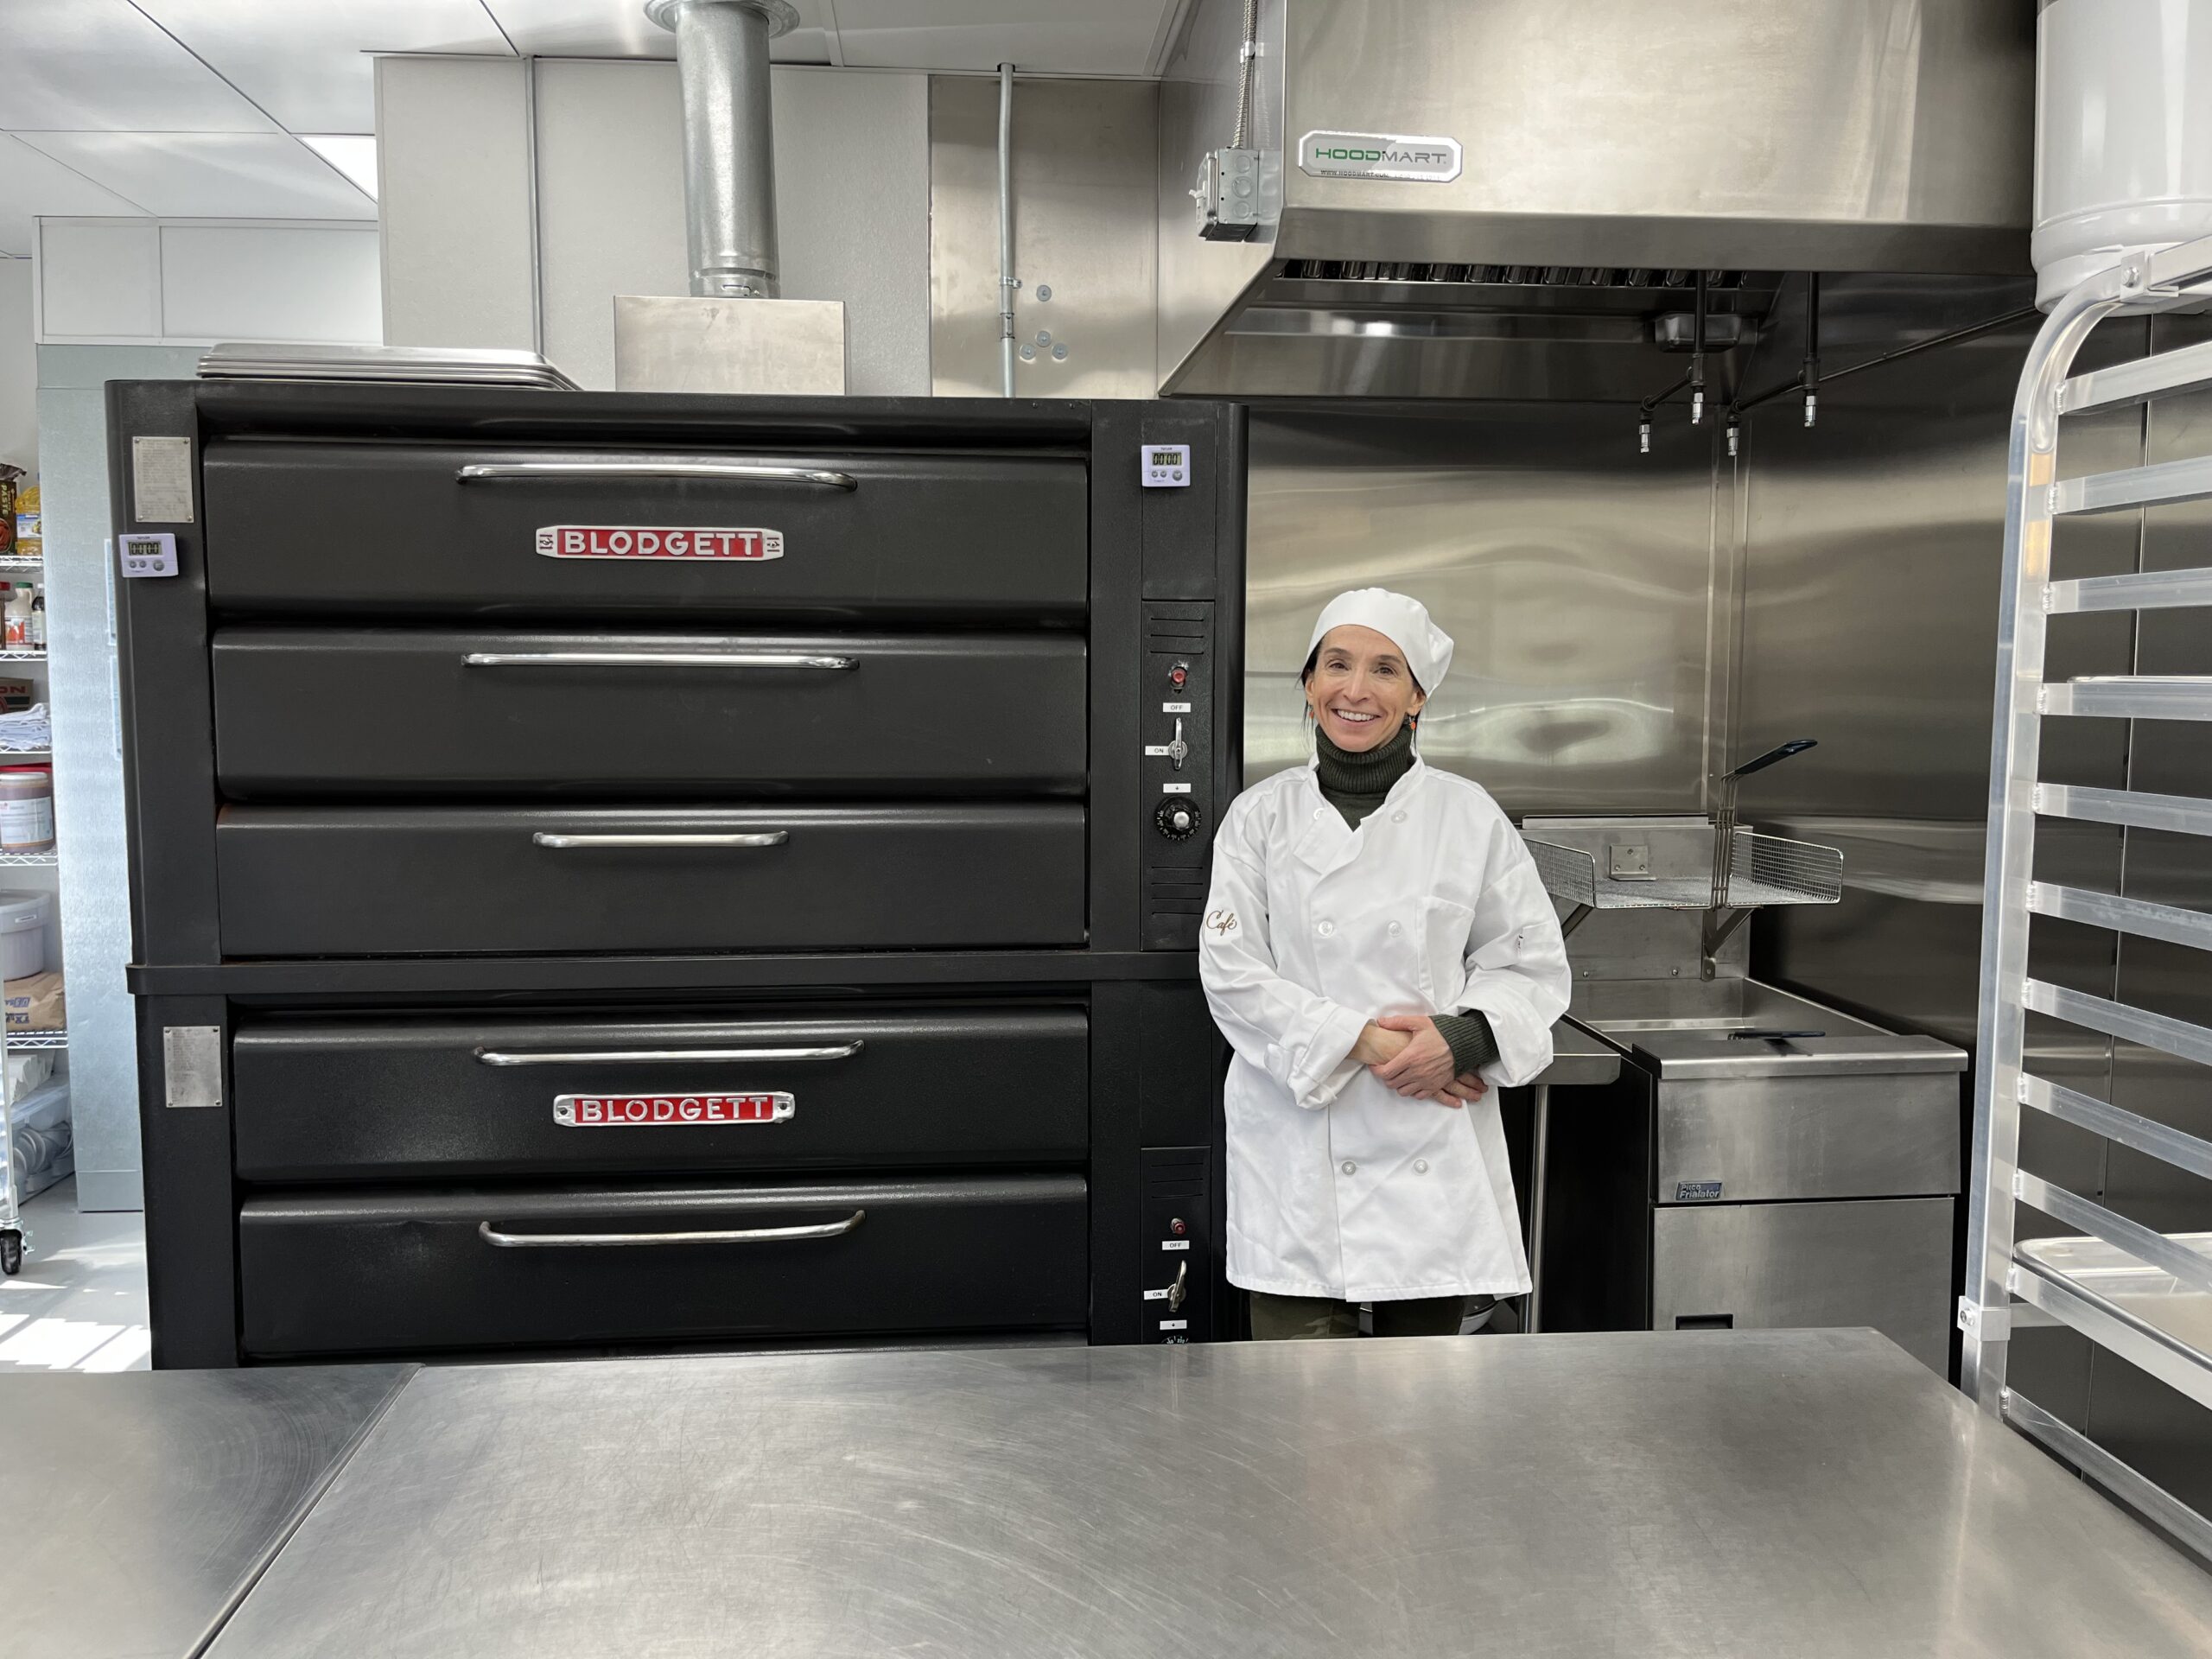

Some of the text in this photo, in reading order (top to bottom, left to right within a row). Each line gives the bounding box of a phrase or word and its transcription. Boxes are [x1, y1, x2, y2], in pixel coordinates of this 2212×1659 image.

[1316, 148, 1446, 163] HOODMART
[564, 531, 759, 556] BLODGETT
[1205, 909, 1237, 937] Café
[582, 1096, 768, 1122] BLODGETT
[1679, 1190, 1720, 1198] Frialator
